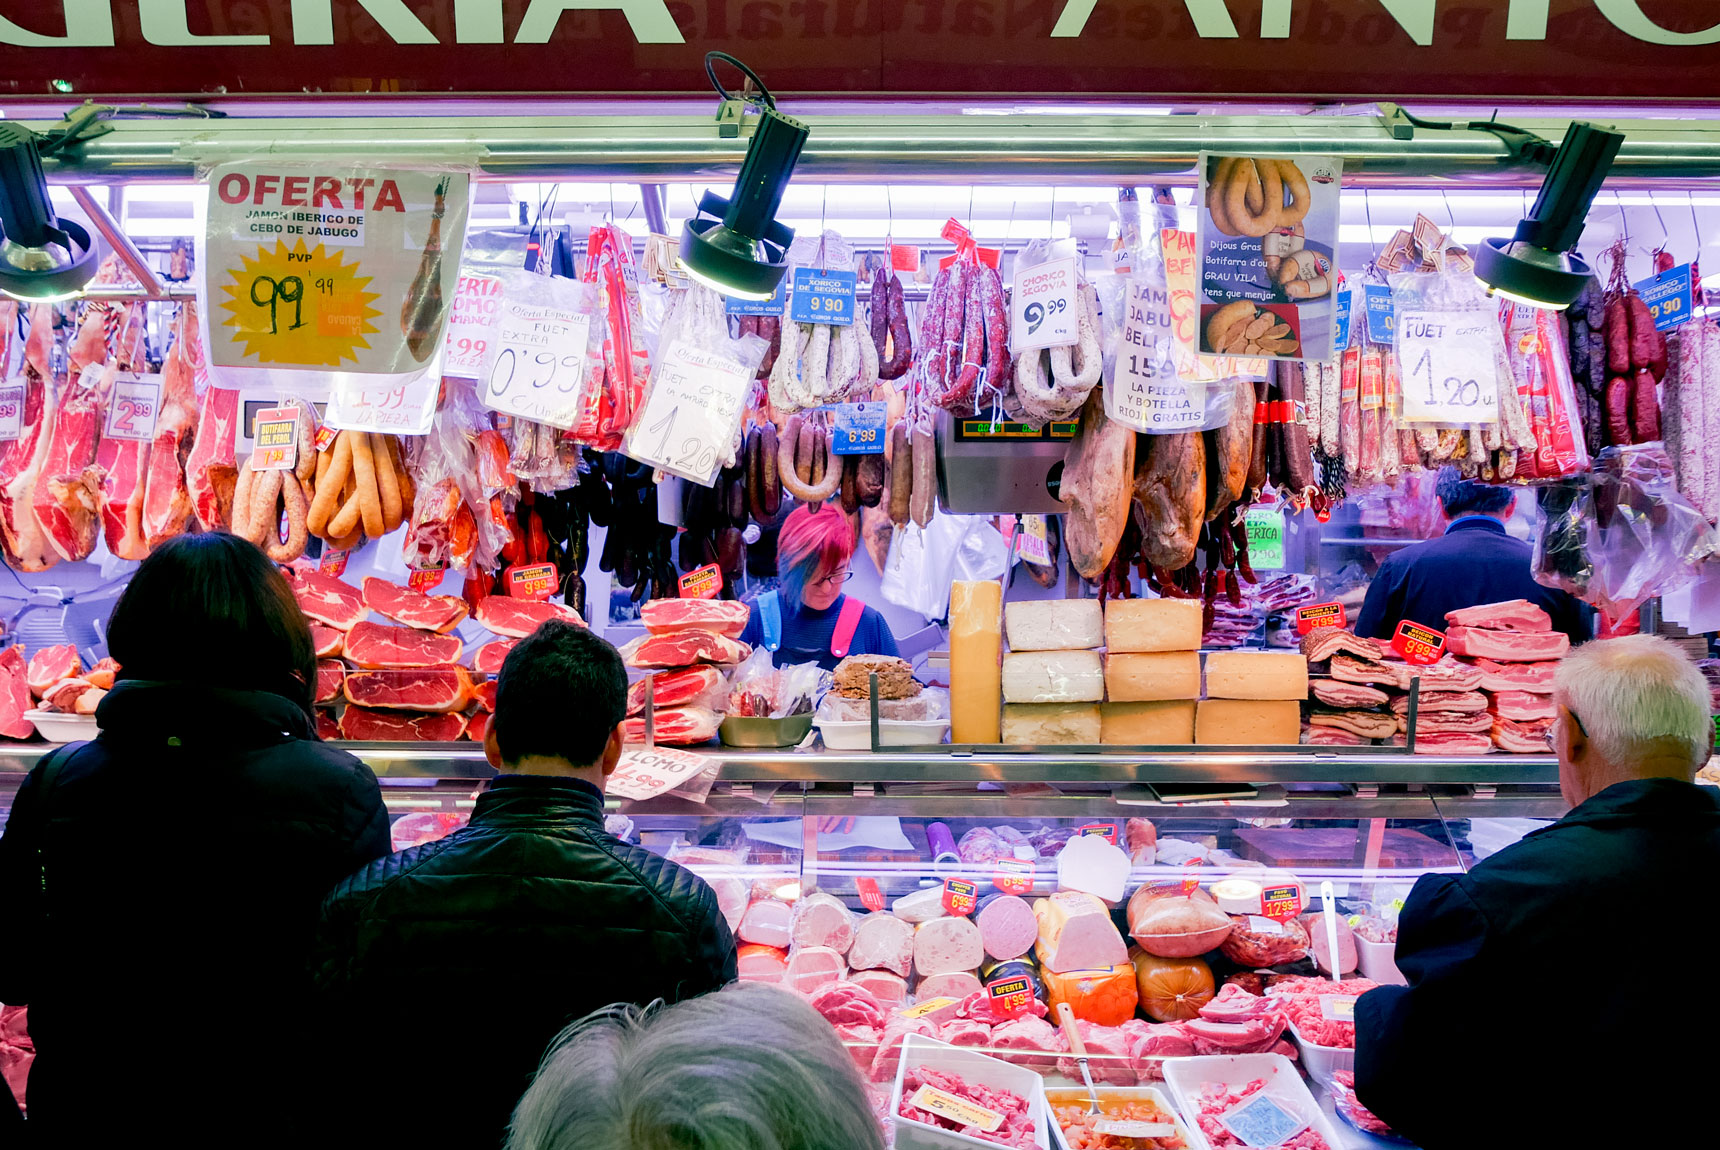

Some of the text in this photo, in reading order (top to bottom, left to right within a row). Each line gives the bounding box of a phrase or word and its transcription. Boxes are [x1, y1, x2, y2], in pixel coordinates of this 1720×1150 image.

[217, 172, 406, 213] OFERTA
[245, 210, 364, 226] JAMON IBERICO DE
[250, 223, 359, 239] CEBO DE JABUGO
[1210, 240, 1262, 252] Dijous Gras
[287, 252, 313, 263] PVP
[1205, 255, 1247, 267] Botifarra
[1204, 271, 1257, 283] GRAU VILA
[798, 284, 851, 295] DE SEGOVIA
[1022, 280, 1067, 298] SEGOVIA
[1204, 287, 1276, 301] tens que menjar
[810, 296, 843, 313] 9'90
[1650, 297, 1681, 319] 9'90
[512, 305, 585, 323] Oferta Especial
[533, 322, 569, 336] FUET
[1404, 319, 1447, 339] FUET
[502, 330, 549, 345] EXTRA
[677, 347, 746, 375] Oferta Especial
[660, 362, 688, 386] FUET
[1131, 382, 1186, 396] LA PIEZA
[1127, 394, 1191, 409] Y BOTELLA
[1119, 405, 1201, 423] RIOJA GRATIS
[261, 422, 292, 435] BUTIFARRA
[260, 433, 291, 445] DEL PEROL
[650, 405, 717, 475] 1,20
[524, 579, 547, 595] 9'99
[1311, 616, 1335, 628] 9'99
[1405, 639, 1431, 656] 9'99
[629, 751, 687, 773] LOMO
[996, 982, 1024, 995] OFERTA
[1004, 993, 1026, 1012] 4'99
